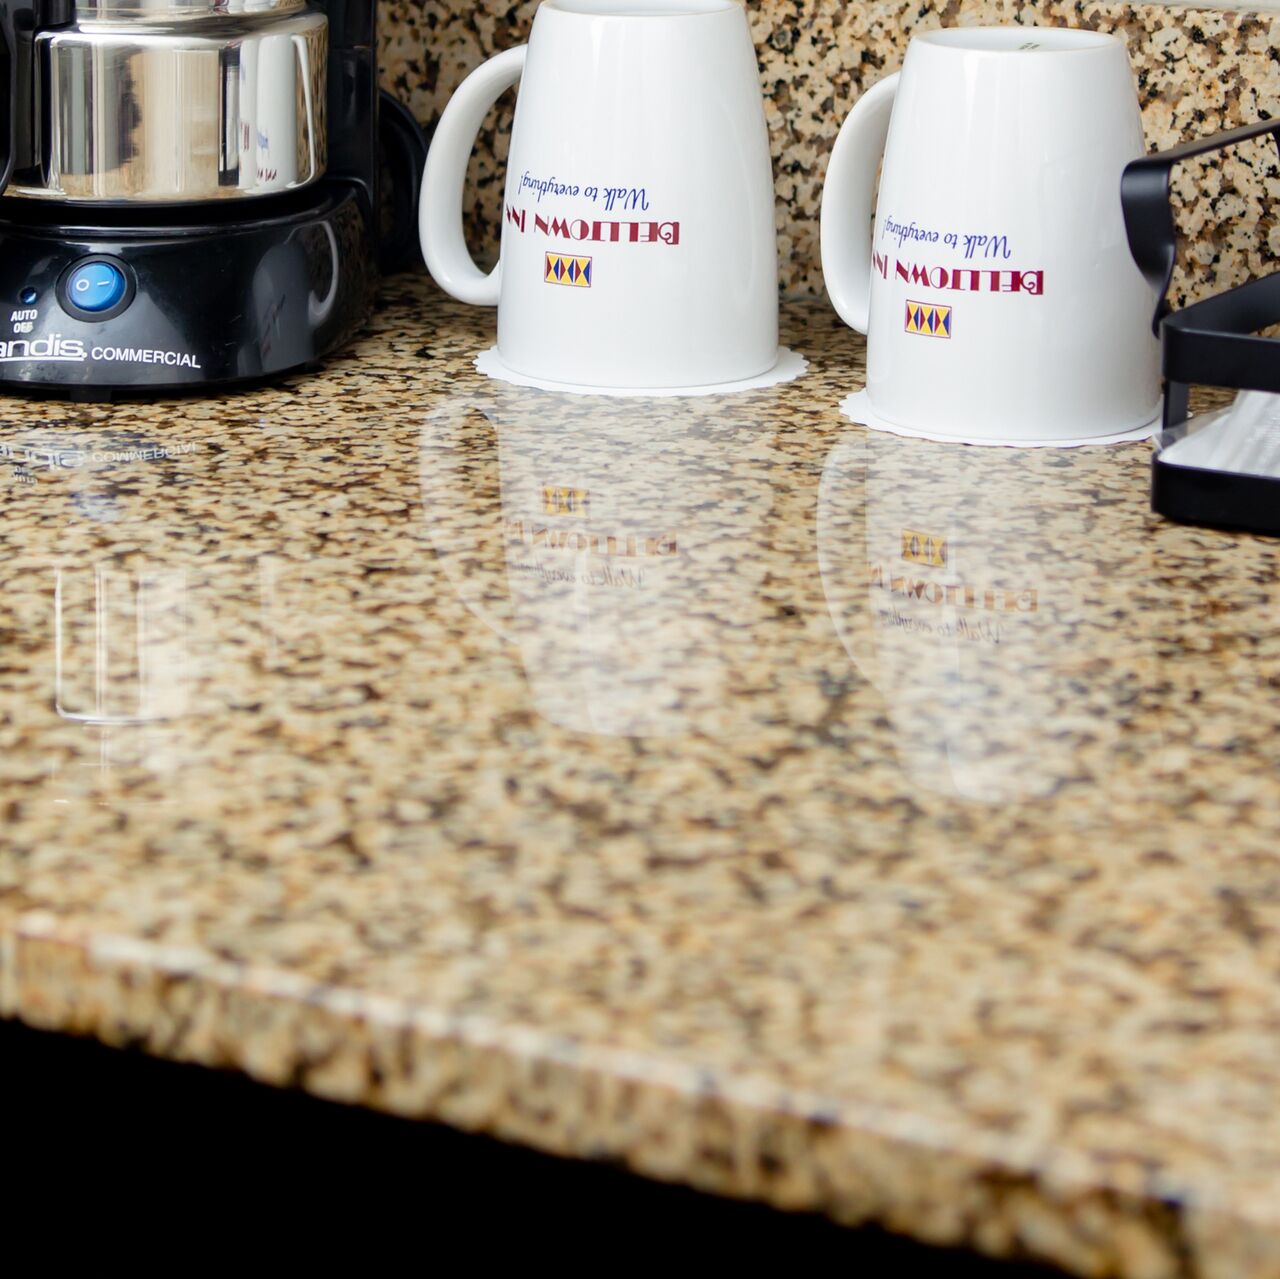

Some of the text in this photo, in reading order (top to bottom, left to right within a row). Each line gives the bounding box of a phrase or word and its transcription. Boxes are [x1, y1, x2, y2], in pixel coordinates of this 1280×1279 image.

[518, 170, 650, 212] Walk to everything!
[533, 213, 680, 245] BELLTOWN
[882, 215, 1012, 259] Walk to everything!
[895, 258, 1044, 296] BELLTOWN
[10, 309, 38, 322] AUTO
[91, 346, 201, 369] COMMERCIAL
